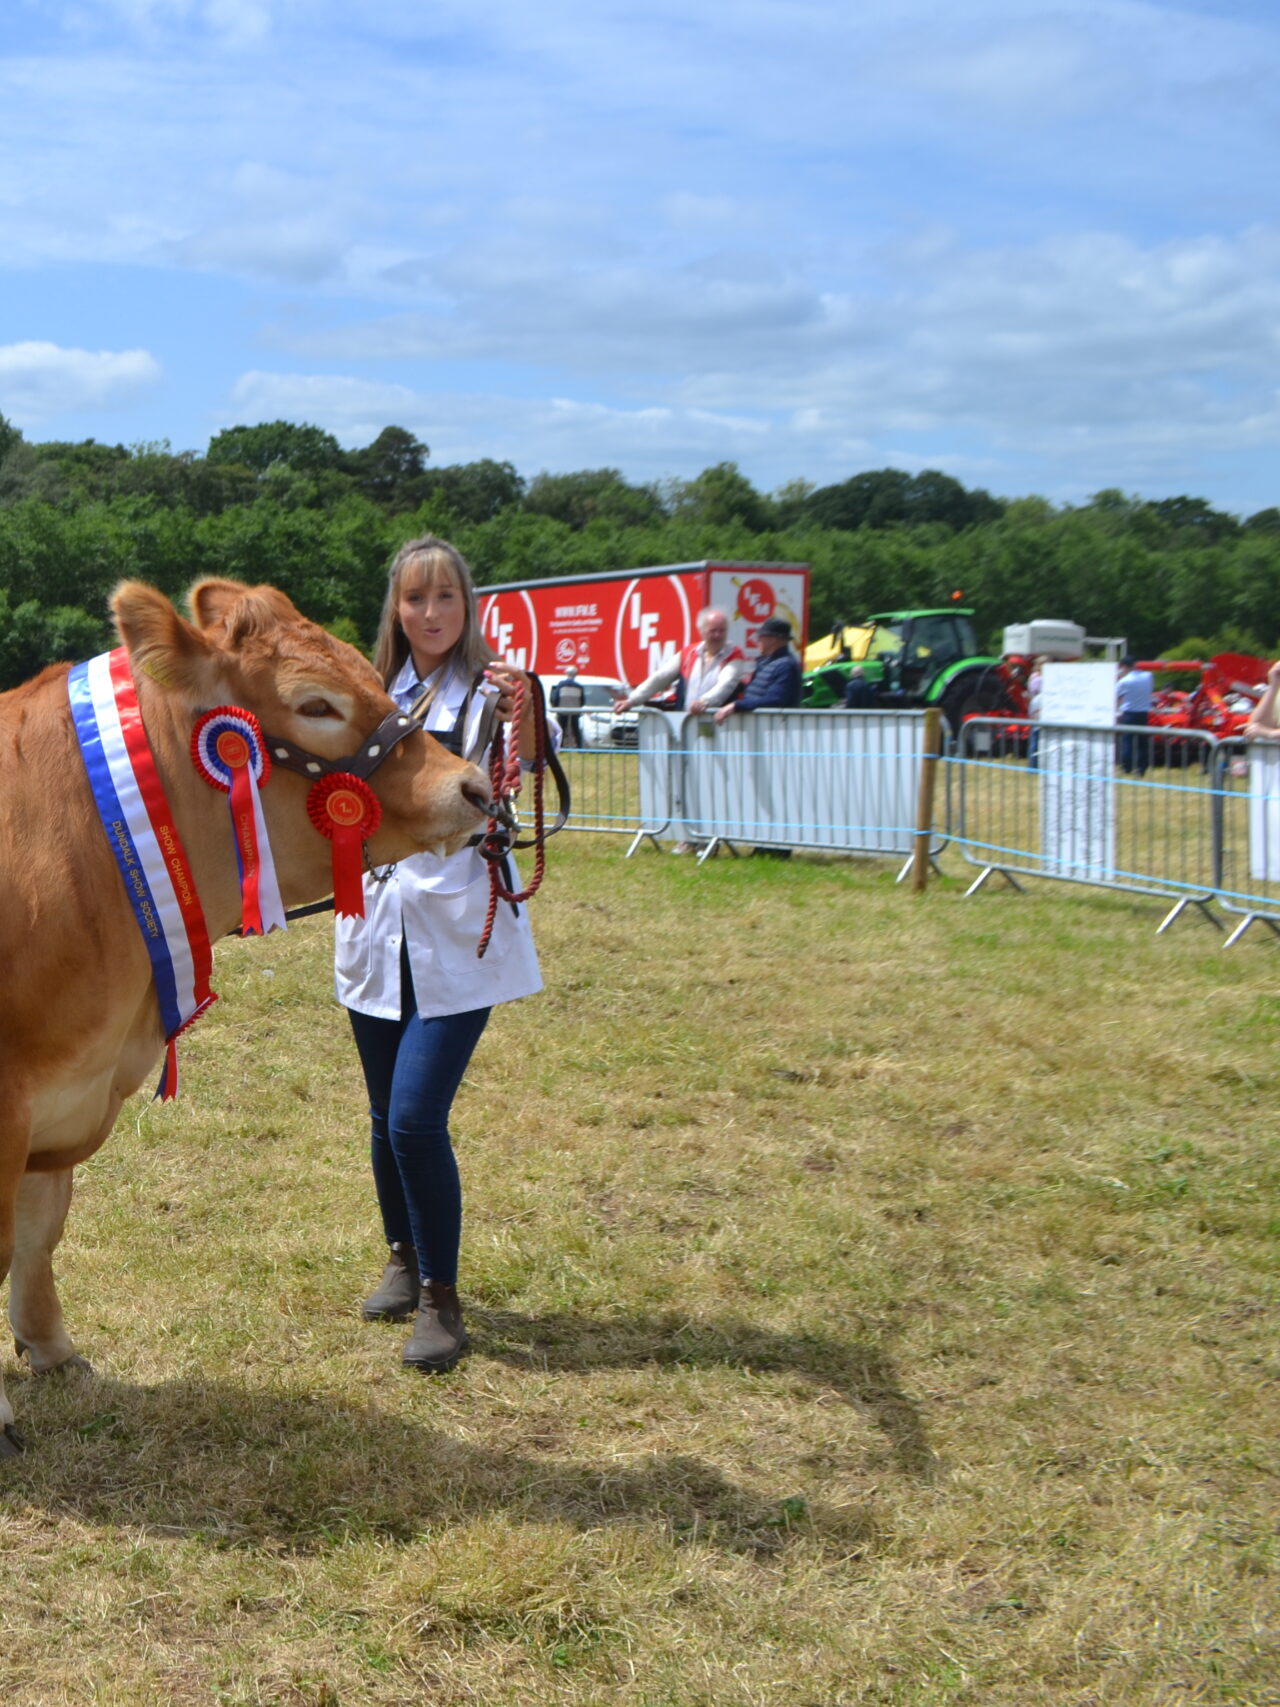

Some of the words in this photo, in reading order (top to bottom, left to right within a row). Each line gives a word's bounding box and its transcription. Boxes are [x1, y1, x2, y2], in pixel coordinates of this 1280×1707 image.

[630, 593, 677, 677] IFM
[744, 586, 770, 616] IFM
[491, 606, 527, 671] IFM
[112, 820, 136, 867] DUNDALK
[130, 869, 146, 898] SHOW
[140, 901, 159, 938] SOCIETY
[160, 825, 177, 855] SHOW
[171, 858, 193, 905] CHAMPION
[239, 814, 256, 878] CHAMPION
